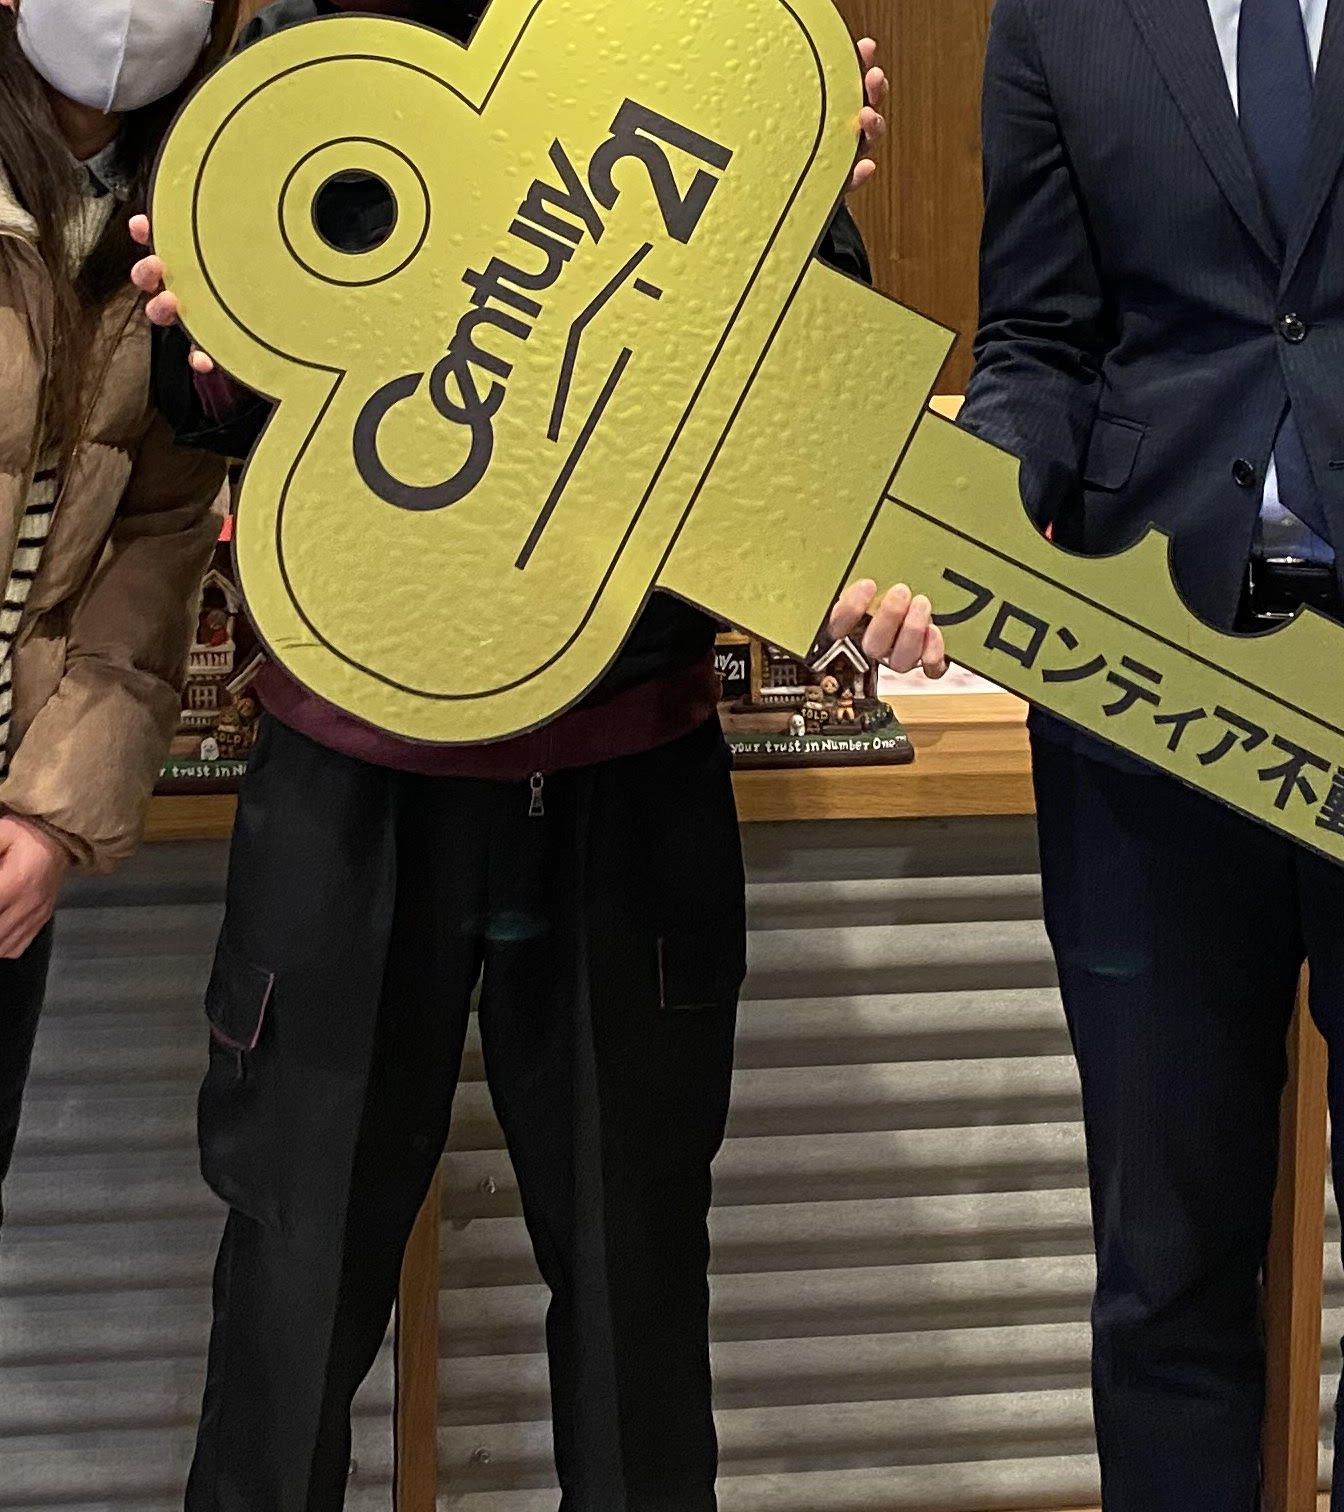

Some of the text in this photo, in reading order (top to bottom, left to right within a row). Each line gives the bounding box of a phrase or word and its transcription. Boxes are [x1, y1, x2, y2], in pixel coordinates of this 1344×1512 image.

[728, 659, 746, 681] 21
[730, 739, 761, 755] your
[765, 739, 802, 754] trust
[804, 739, 820, 754] in
[821, 737, 870, 752] Number
[171, 764, 211, 778] trust
[214, 764, 231, 777] in
